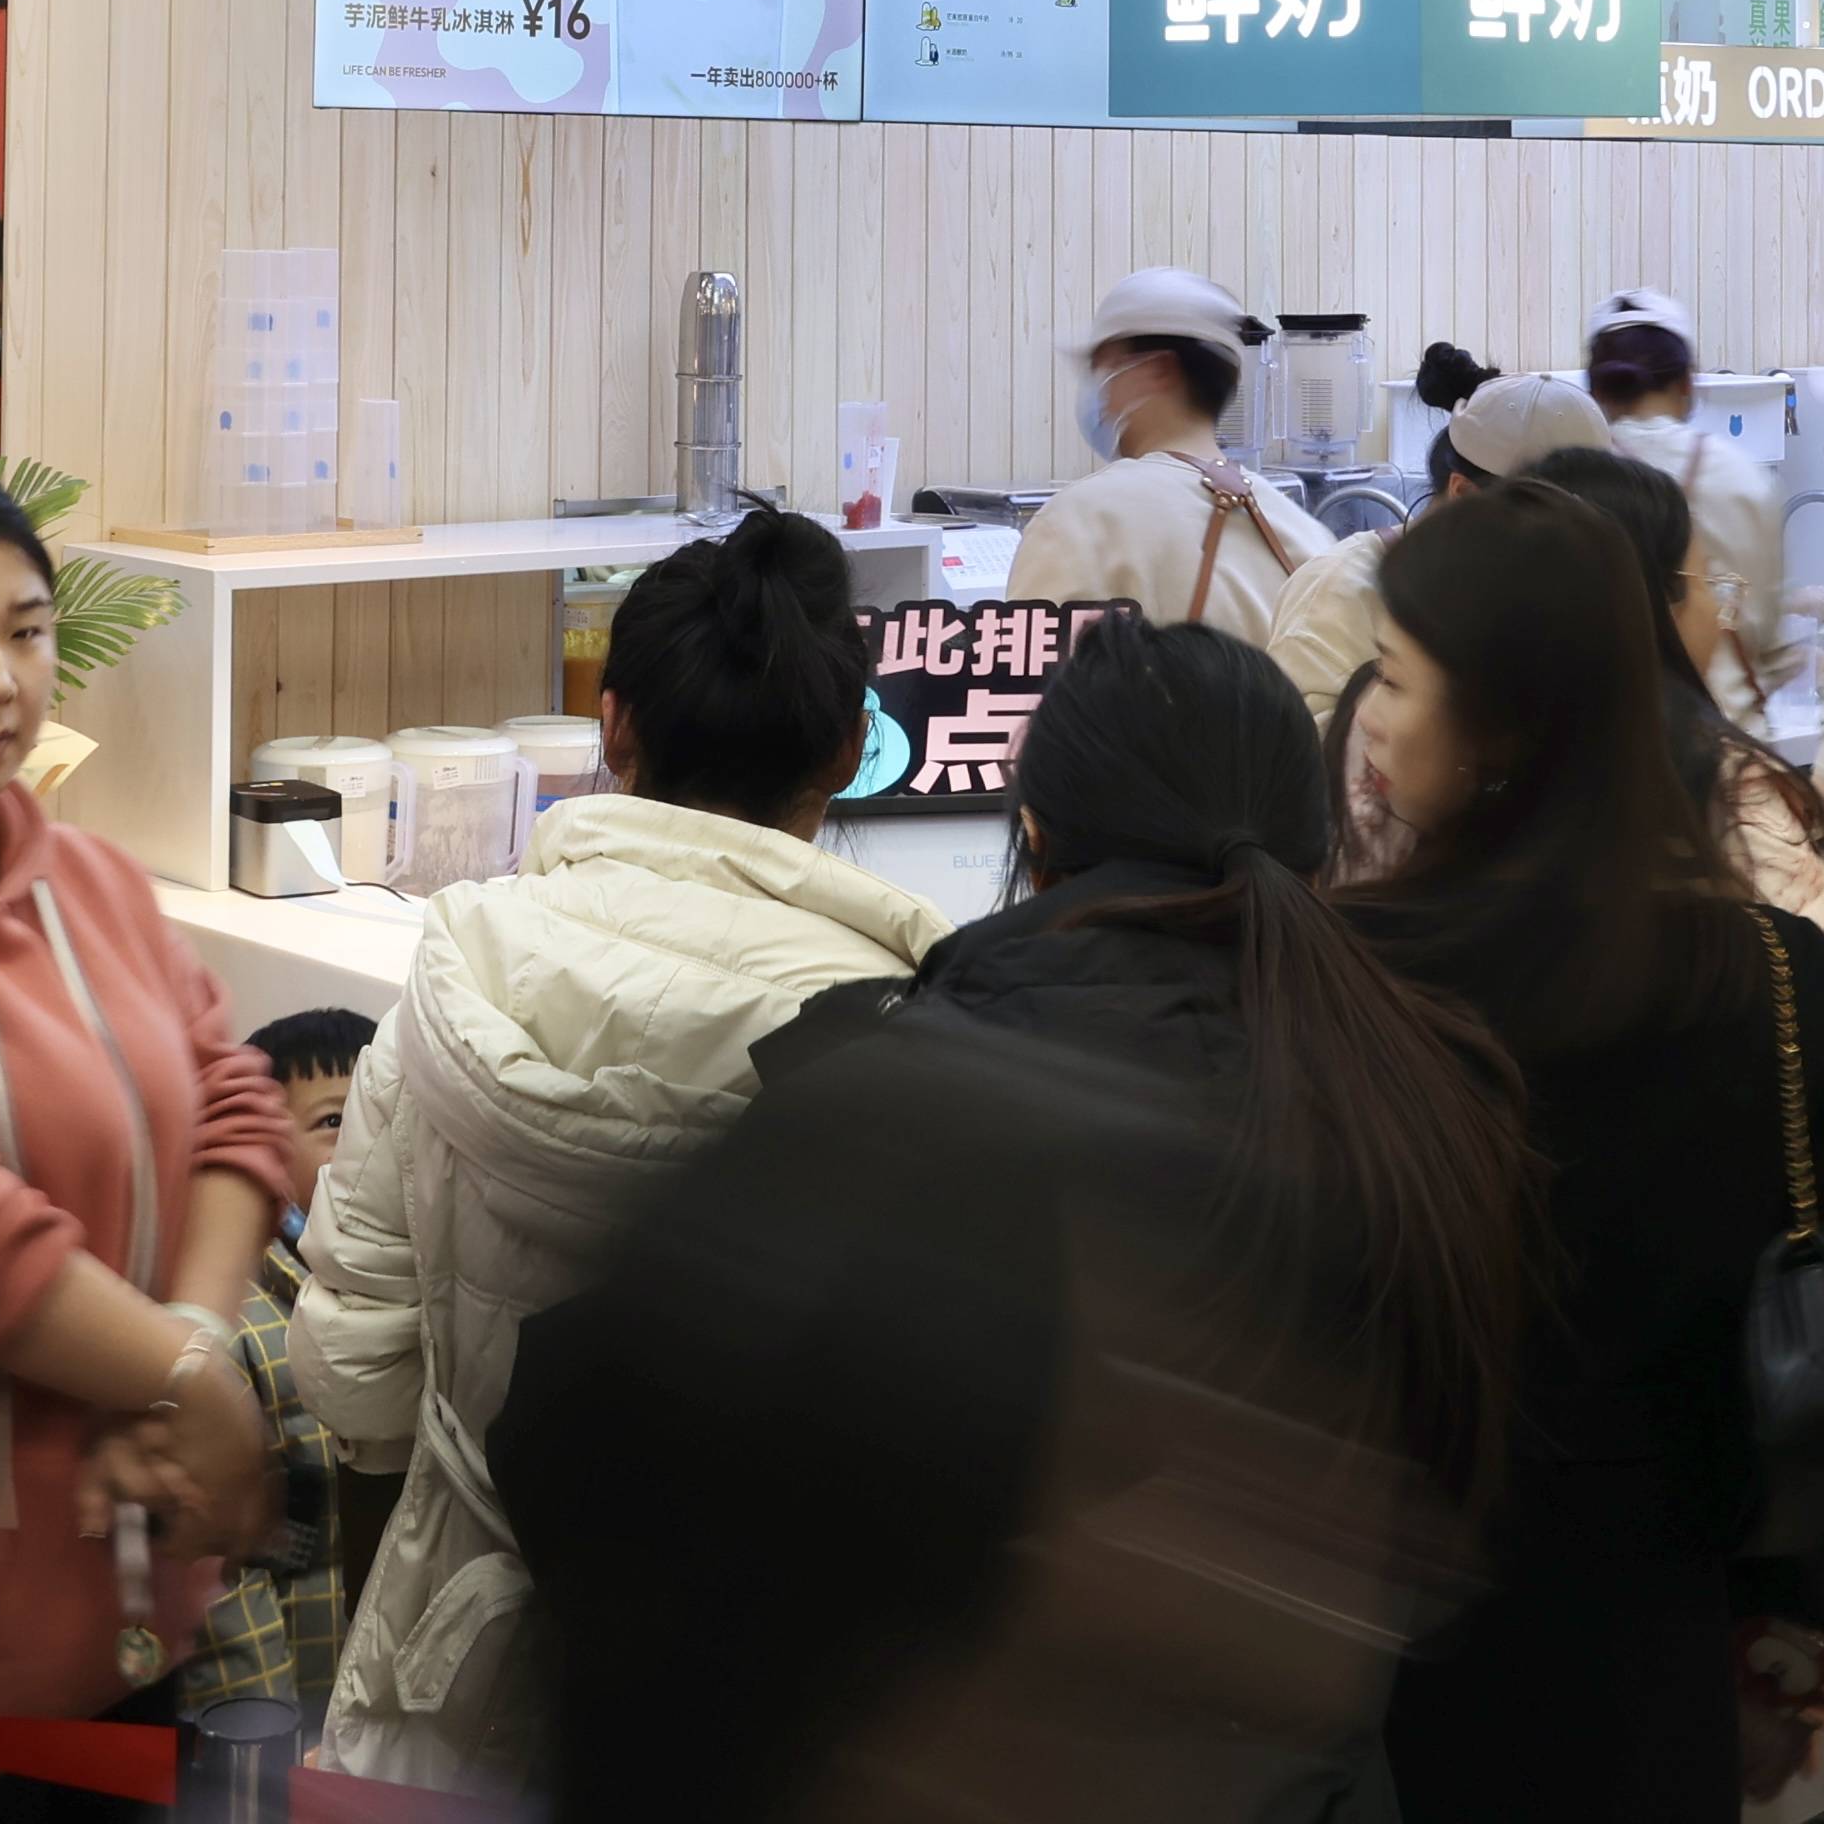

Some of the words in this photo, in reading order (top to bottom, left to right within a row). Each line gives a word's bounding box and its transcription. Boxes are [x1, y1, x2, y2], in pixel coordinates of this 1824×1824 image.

[344, 2, 515, 35] 芋泥鲜牛乳冰淇淋
[342, 64, 364, 75] LIFE
[365, 65, 387, 77] CAN
[388, 66, 401, 77] BE
[403, 67, 446, 78] FRESHER
[690, 65, 839, 92] 一年卖出800000+杯
